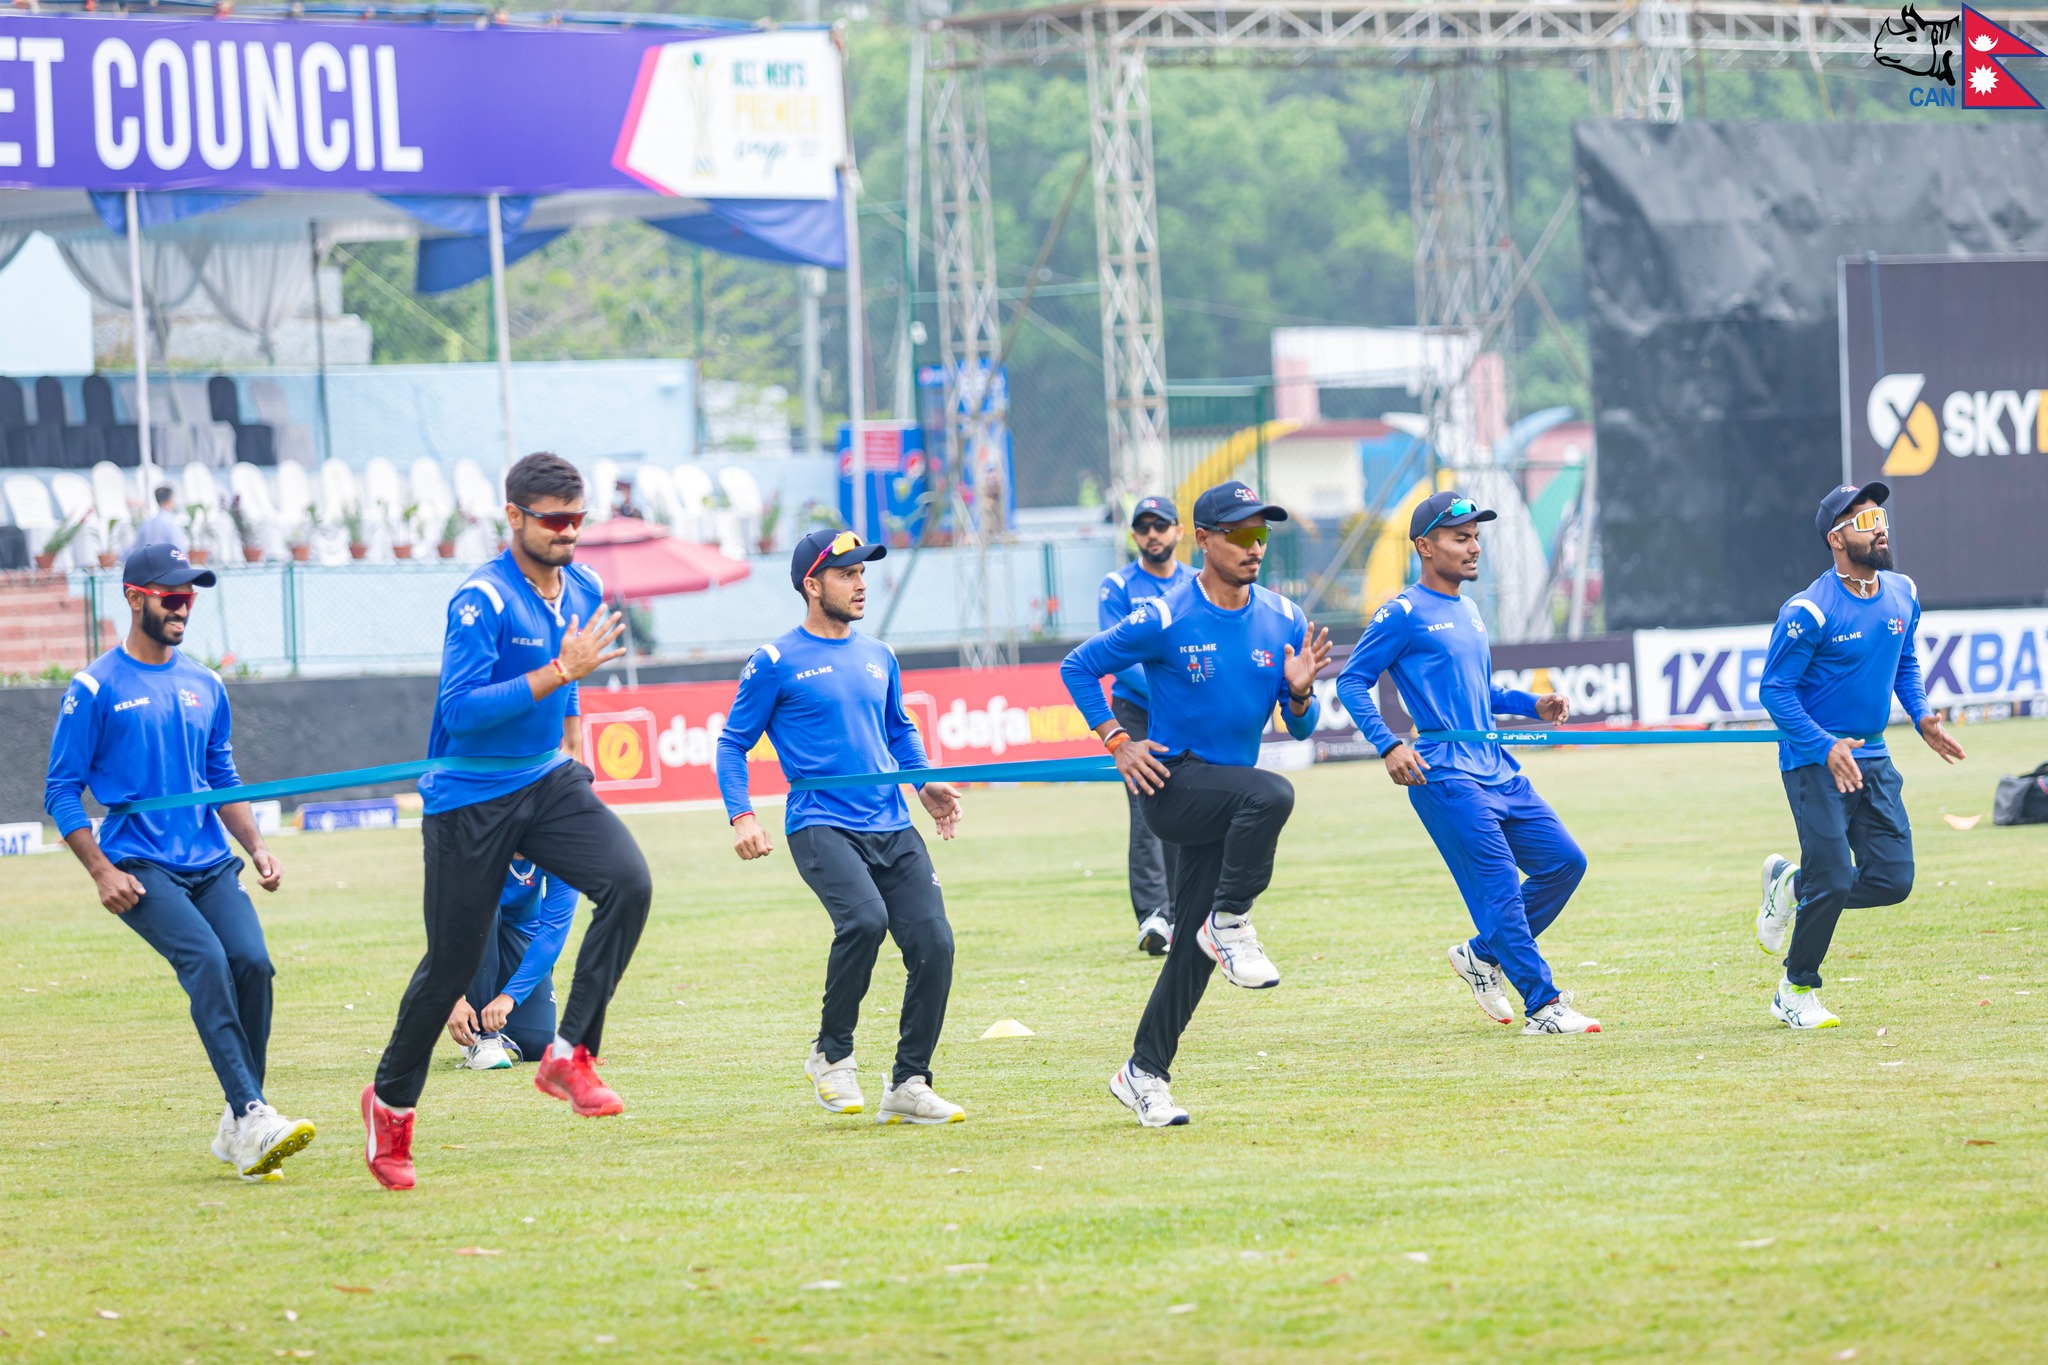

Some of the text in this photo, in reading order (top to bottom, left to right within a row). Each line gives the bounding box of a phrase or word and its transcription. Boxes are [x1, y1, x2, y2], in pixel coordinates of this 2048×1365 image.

[92, 37, 424, 172] COUNCIL
[1427, 622, 1455, 632] KELME
[511, 637, 544, 647] KELME
[1831, 631, 1863, 643] KELME
[1180, 643, 1217, 653] KELME
[1924, 631, 2048, 696] XBA
[796, 665, 834, 680] KELME
[113, 697, 151, 712] KELME
